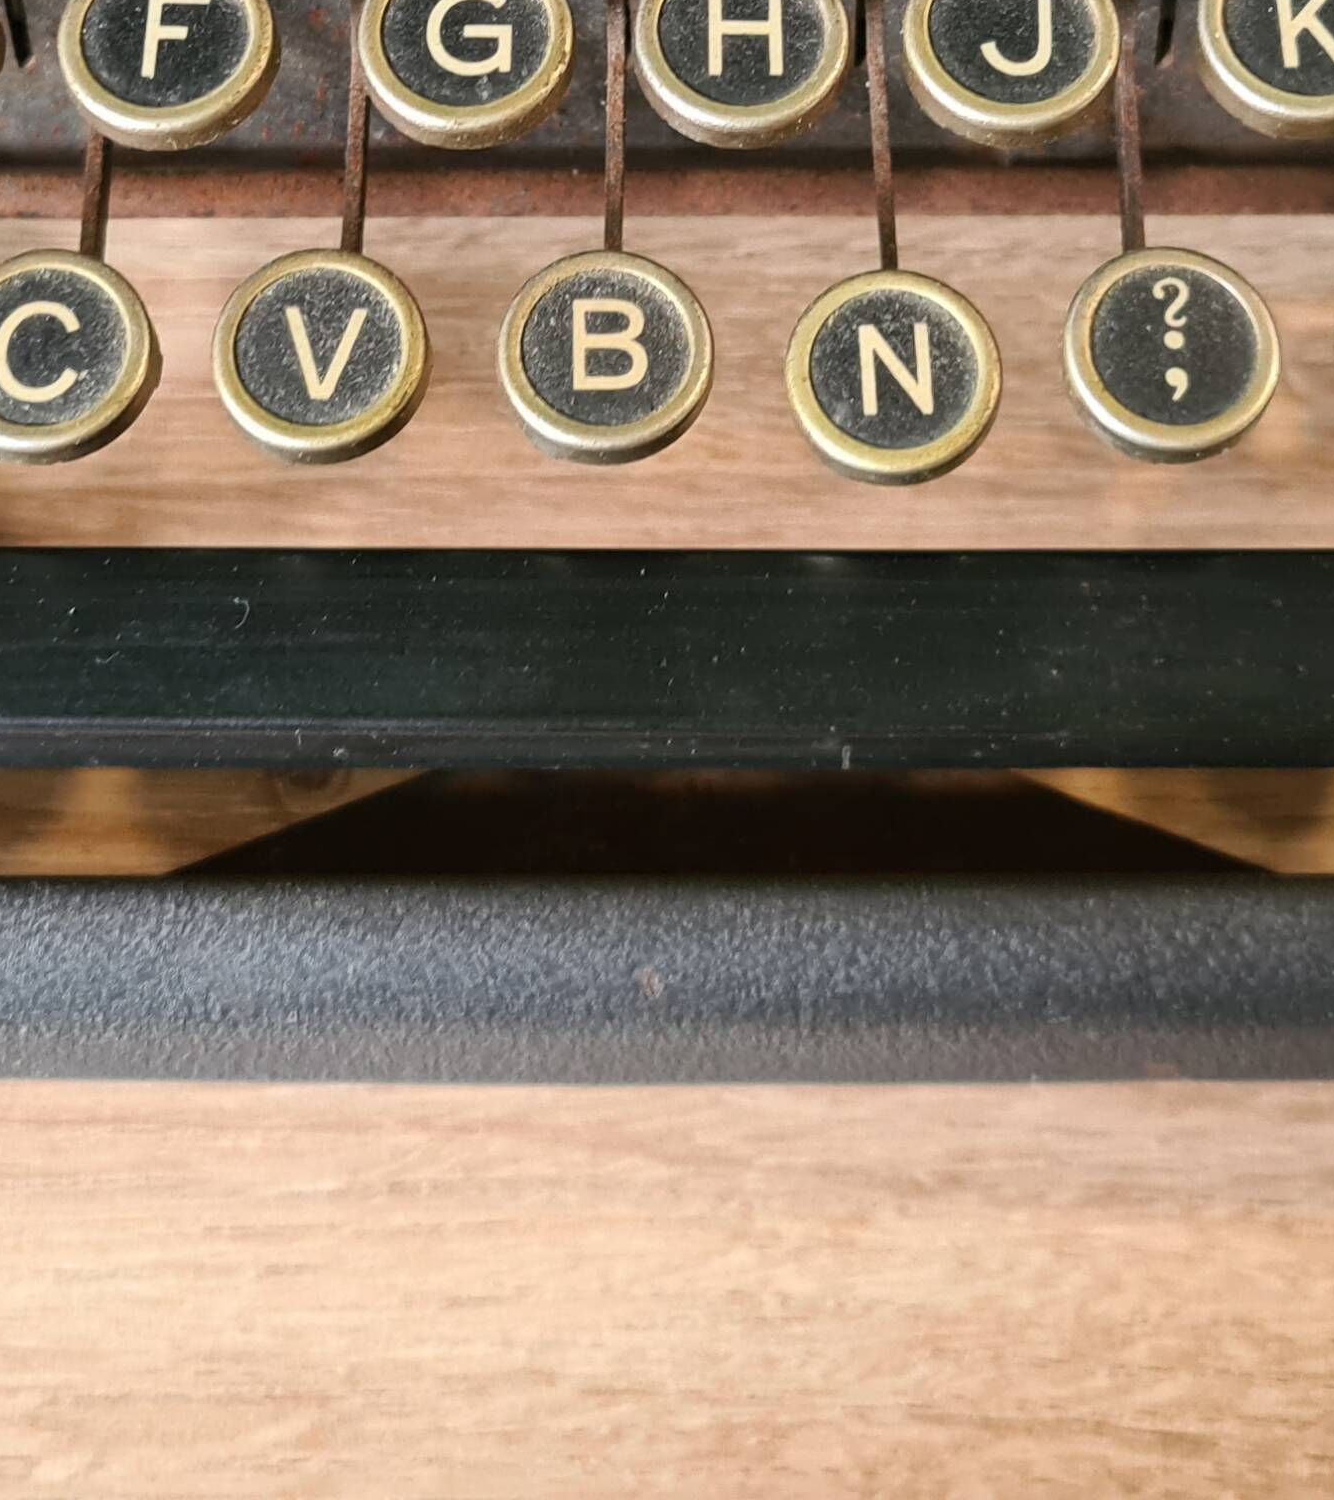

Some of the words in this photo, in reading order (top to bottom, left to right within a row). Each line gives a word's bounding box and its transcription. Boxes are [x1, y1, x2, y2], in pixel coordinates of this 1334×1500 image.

[286, 306, 368, 400] V
[572, 297, 648, 390] B
[1153, 277, 1189, 349] ?
[858, 321, 933, 416] N
